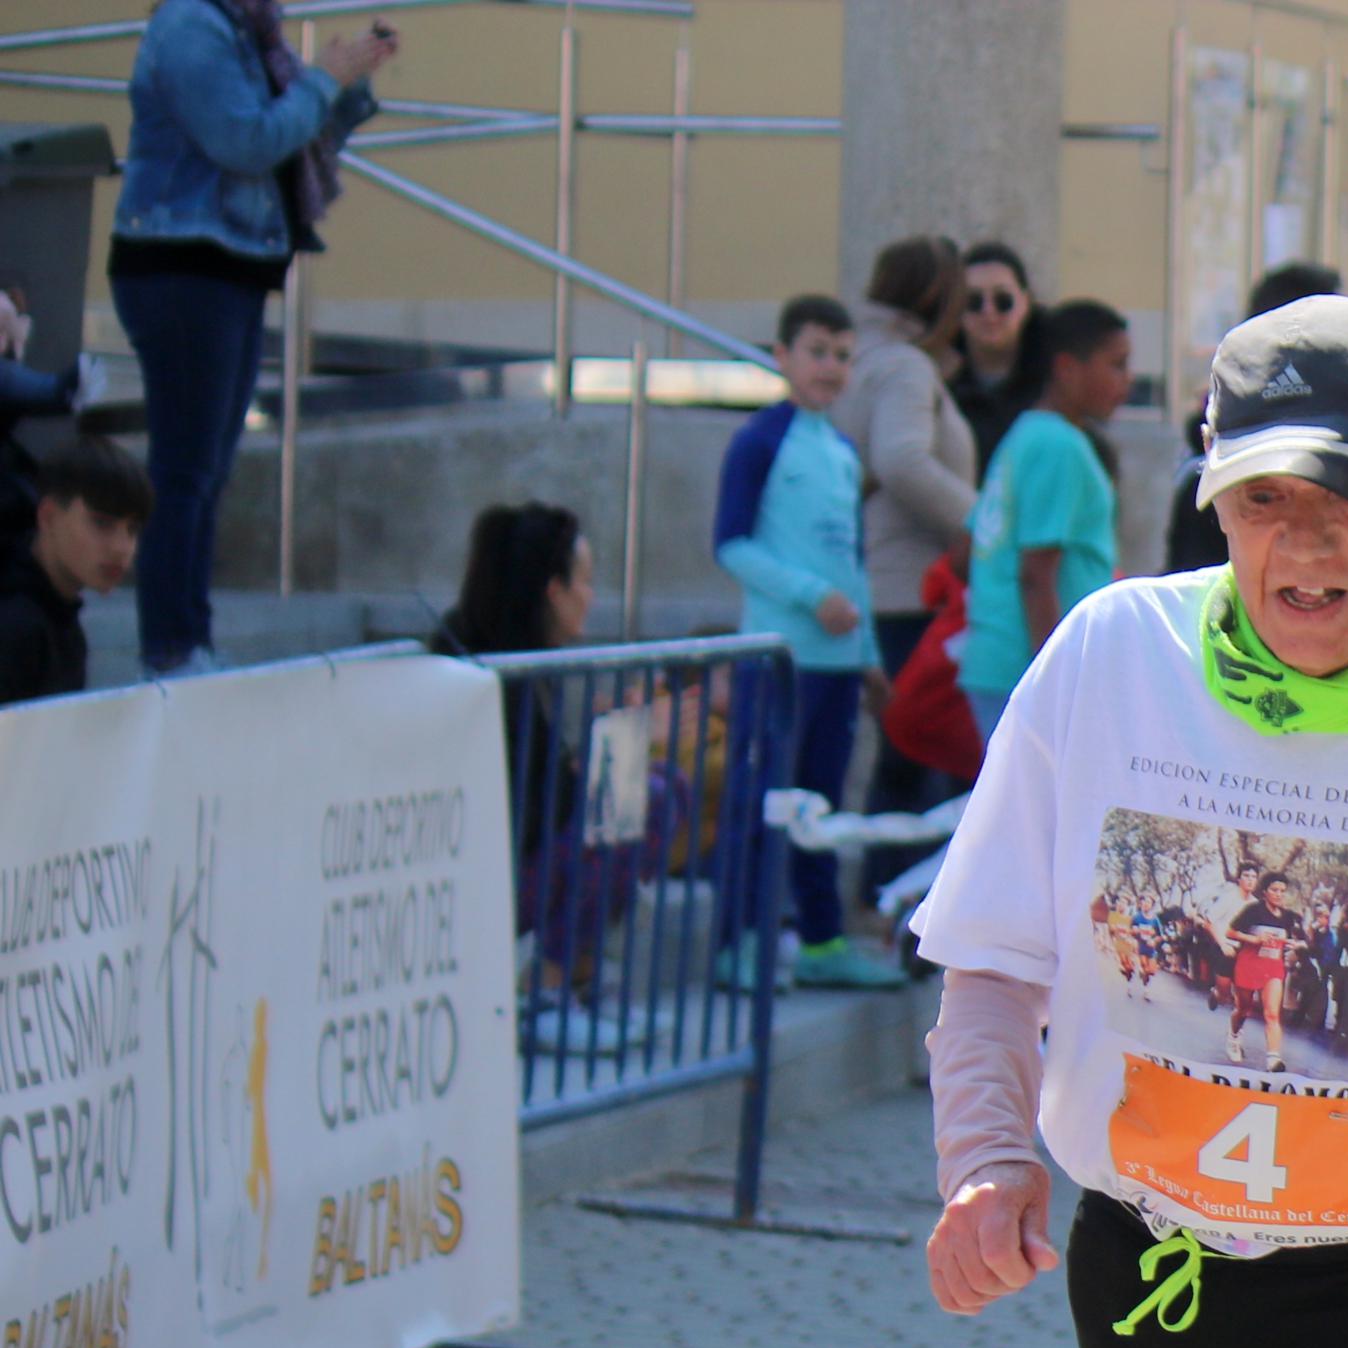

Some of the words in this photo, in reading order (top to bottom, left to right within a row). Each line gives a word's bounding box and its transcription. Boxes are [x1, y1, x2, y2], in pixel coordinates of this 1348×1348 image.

[1262, 385, 1312, 399] adidas
[1130, 756, 1211, 785] EDICION
[1219, 772, 1314, 801] ESPECIAL
[1178, 793, 1190, 809] A
[1197, 795, 1218, 813] LA
[1225, 802, 1331, 831] MEMORIA
[320, 800, 366, 881] CLUB
[0, 864, 37, 953] LUB
[317, 882, 416, 1003] ATLETISMO
[424, 877, 458, 977] DEL
[316, 993, 459, 1131] CERRATO
[0, 1072, 136, 1244] CERRATO
[1197, 1101, 1288, 1203] 4
[1191, 1192, 1282, 1222] Castellana
[1287, 1208, 1313, 1222] del
[1253, 1231, 1296, 1243] Eres
